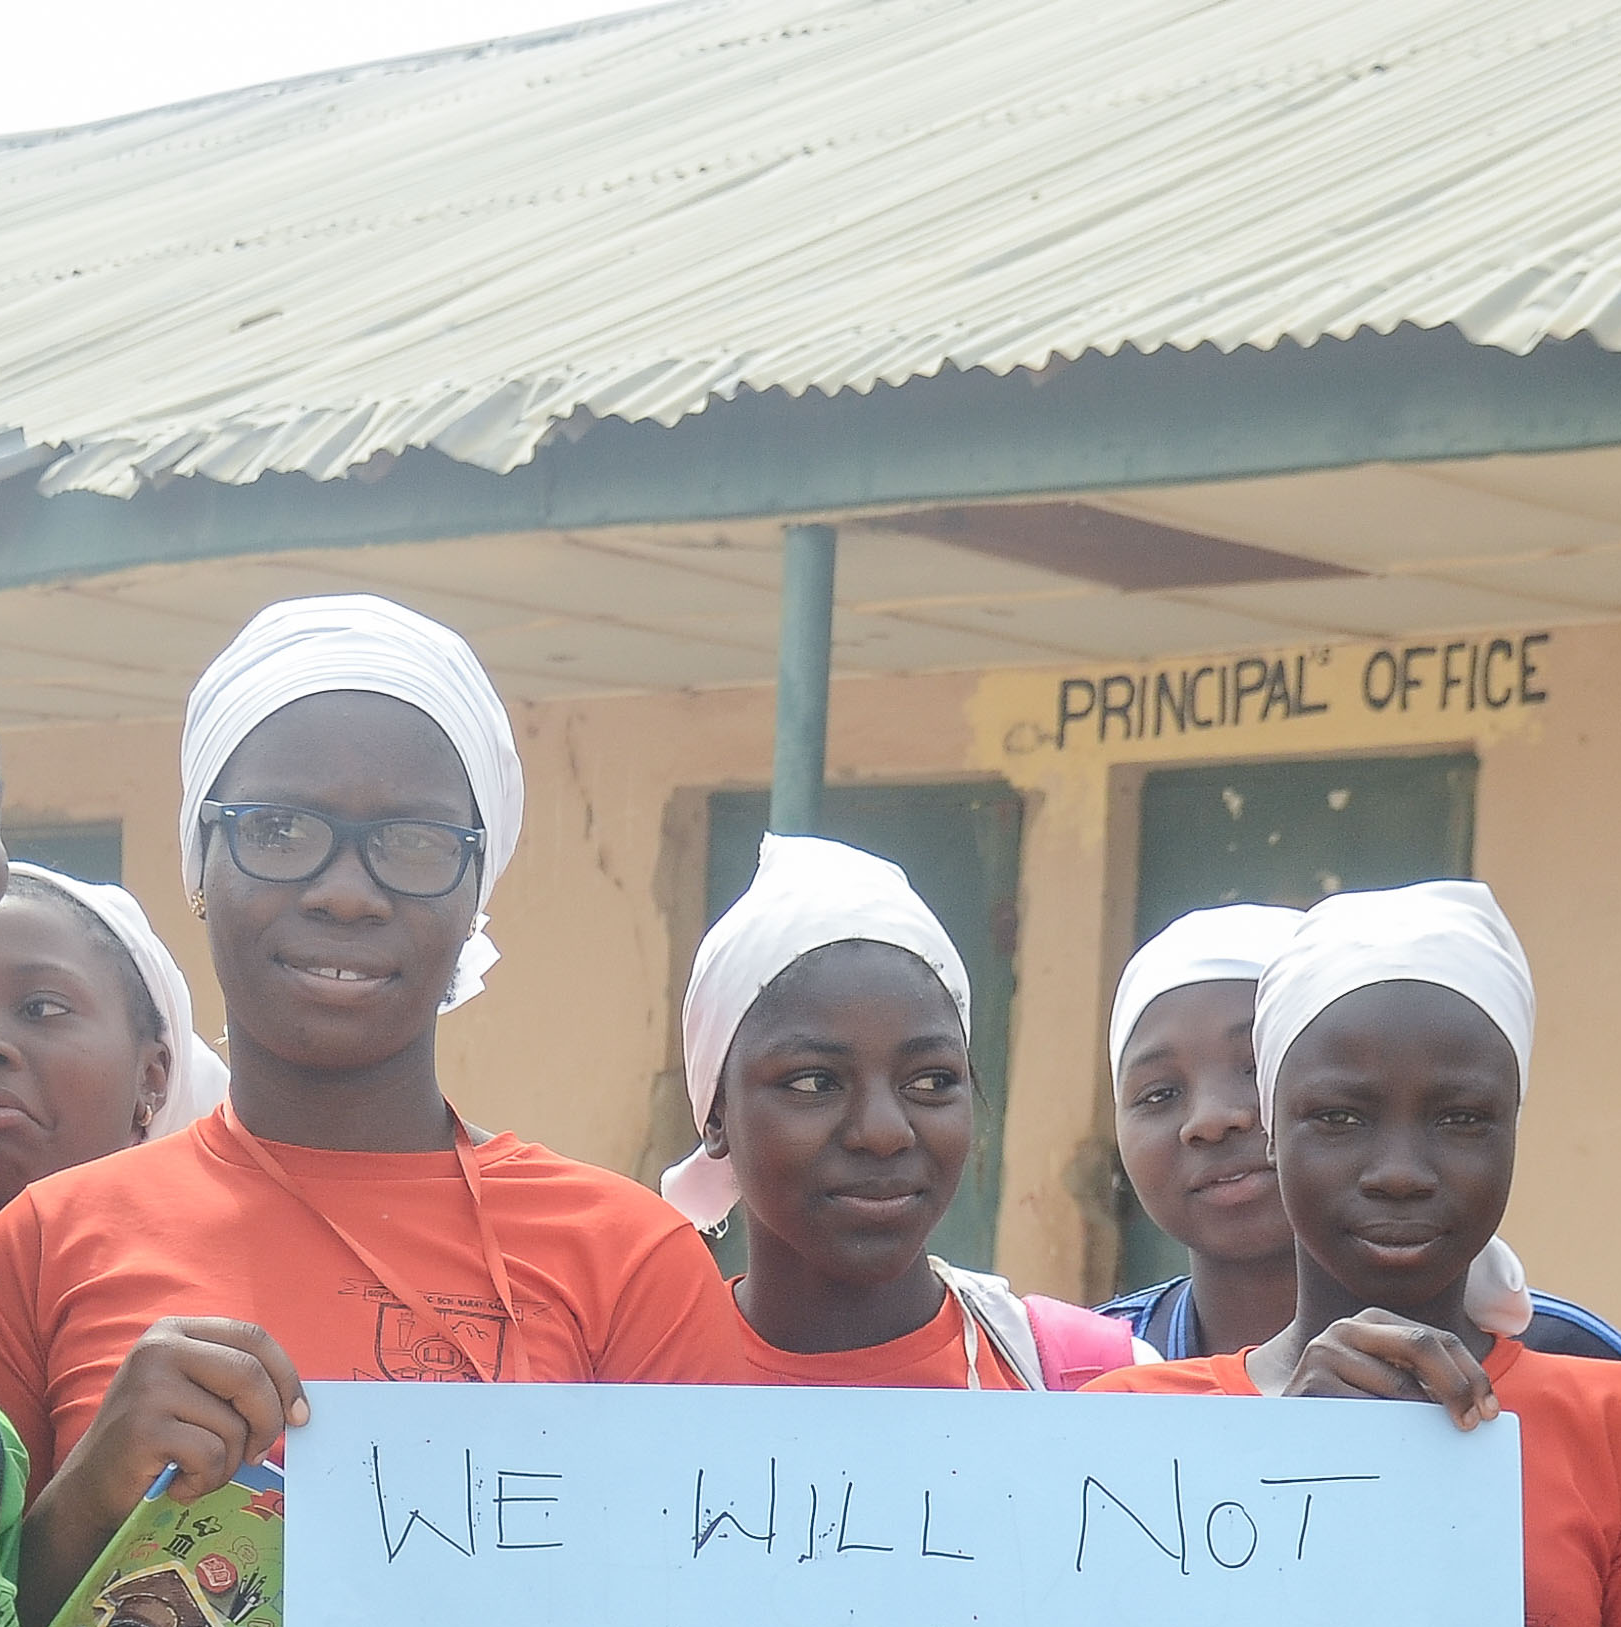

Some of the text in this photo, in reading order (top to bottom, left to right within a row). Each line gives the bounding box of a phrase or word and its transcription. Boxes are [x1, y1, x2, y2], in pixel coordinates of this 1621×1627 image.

[1362, 633, 1549, 712] OFFICE
[372, 1445, 1381, 1576] WE WILL NOT
